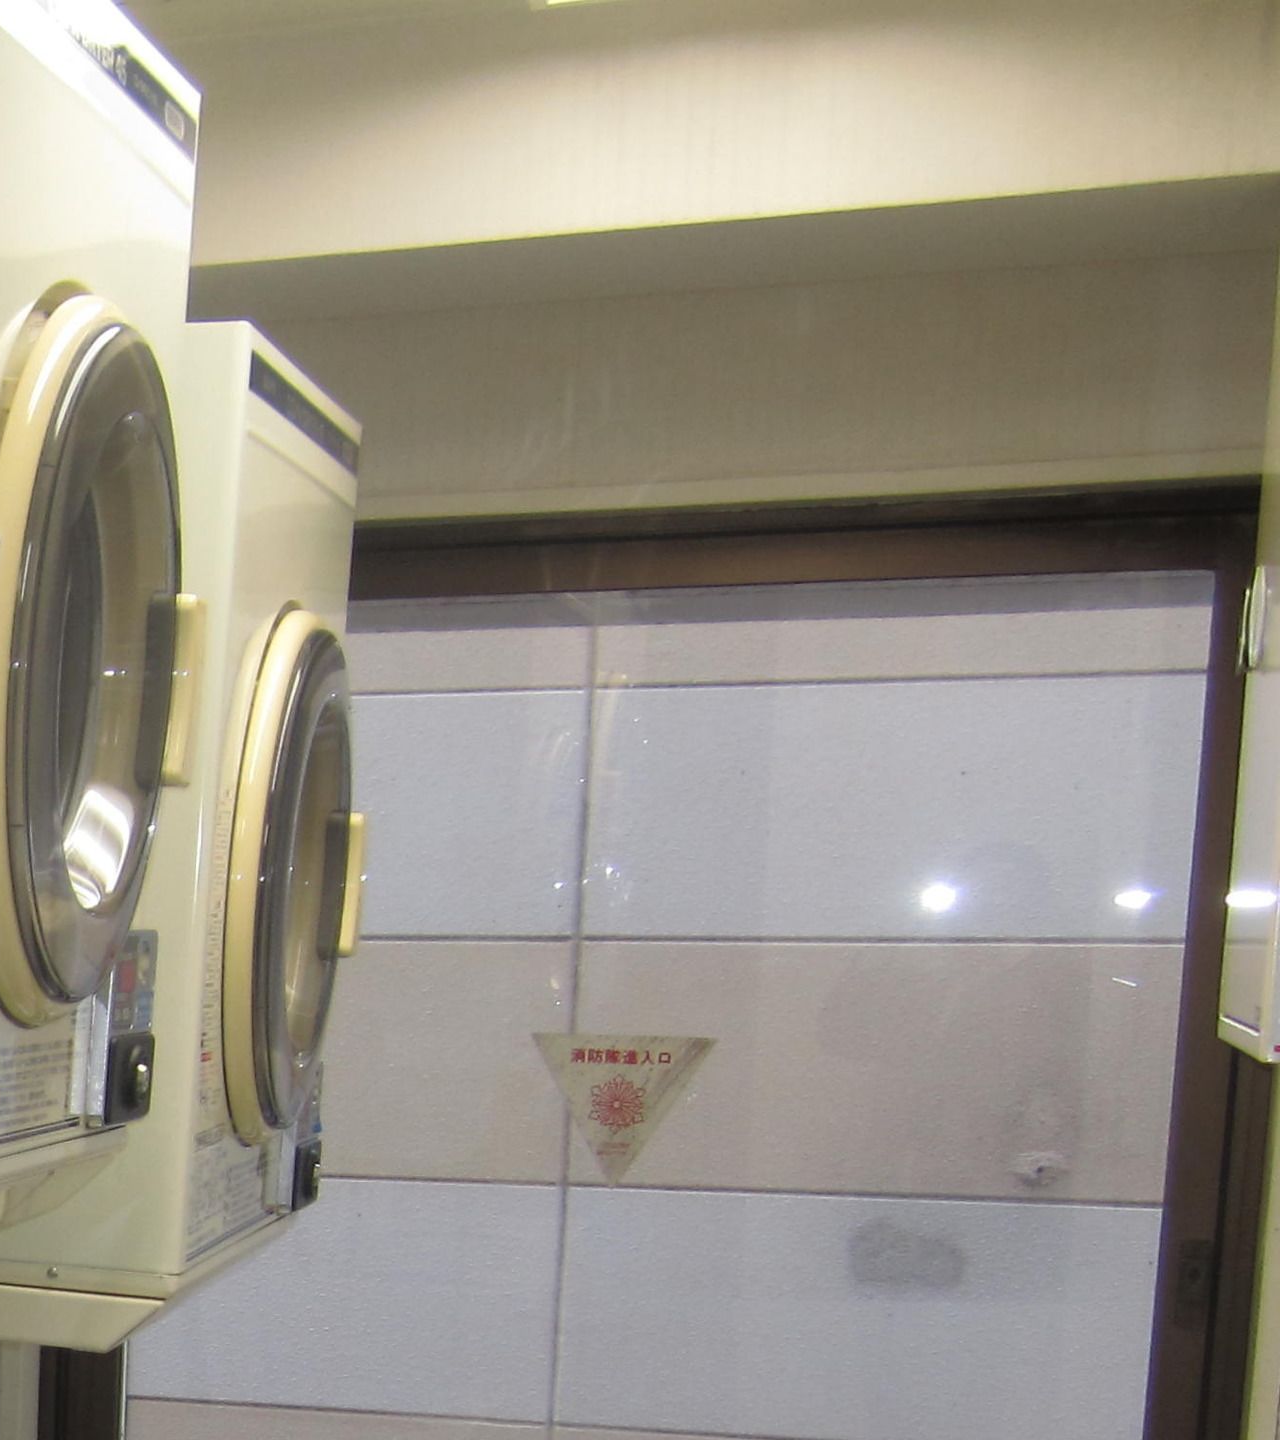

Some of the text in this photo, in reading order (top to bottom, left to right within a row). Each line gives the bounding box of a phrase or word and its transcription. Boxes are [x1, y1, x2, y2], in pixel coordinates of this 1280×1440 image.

[570, 1048, 672, 1065] 消防隊進入口
